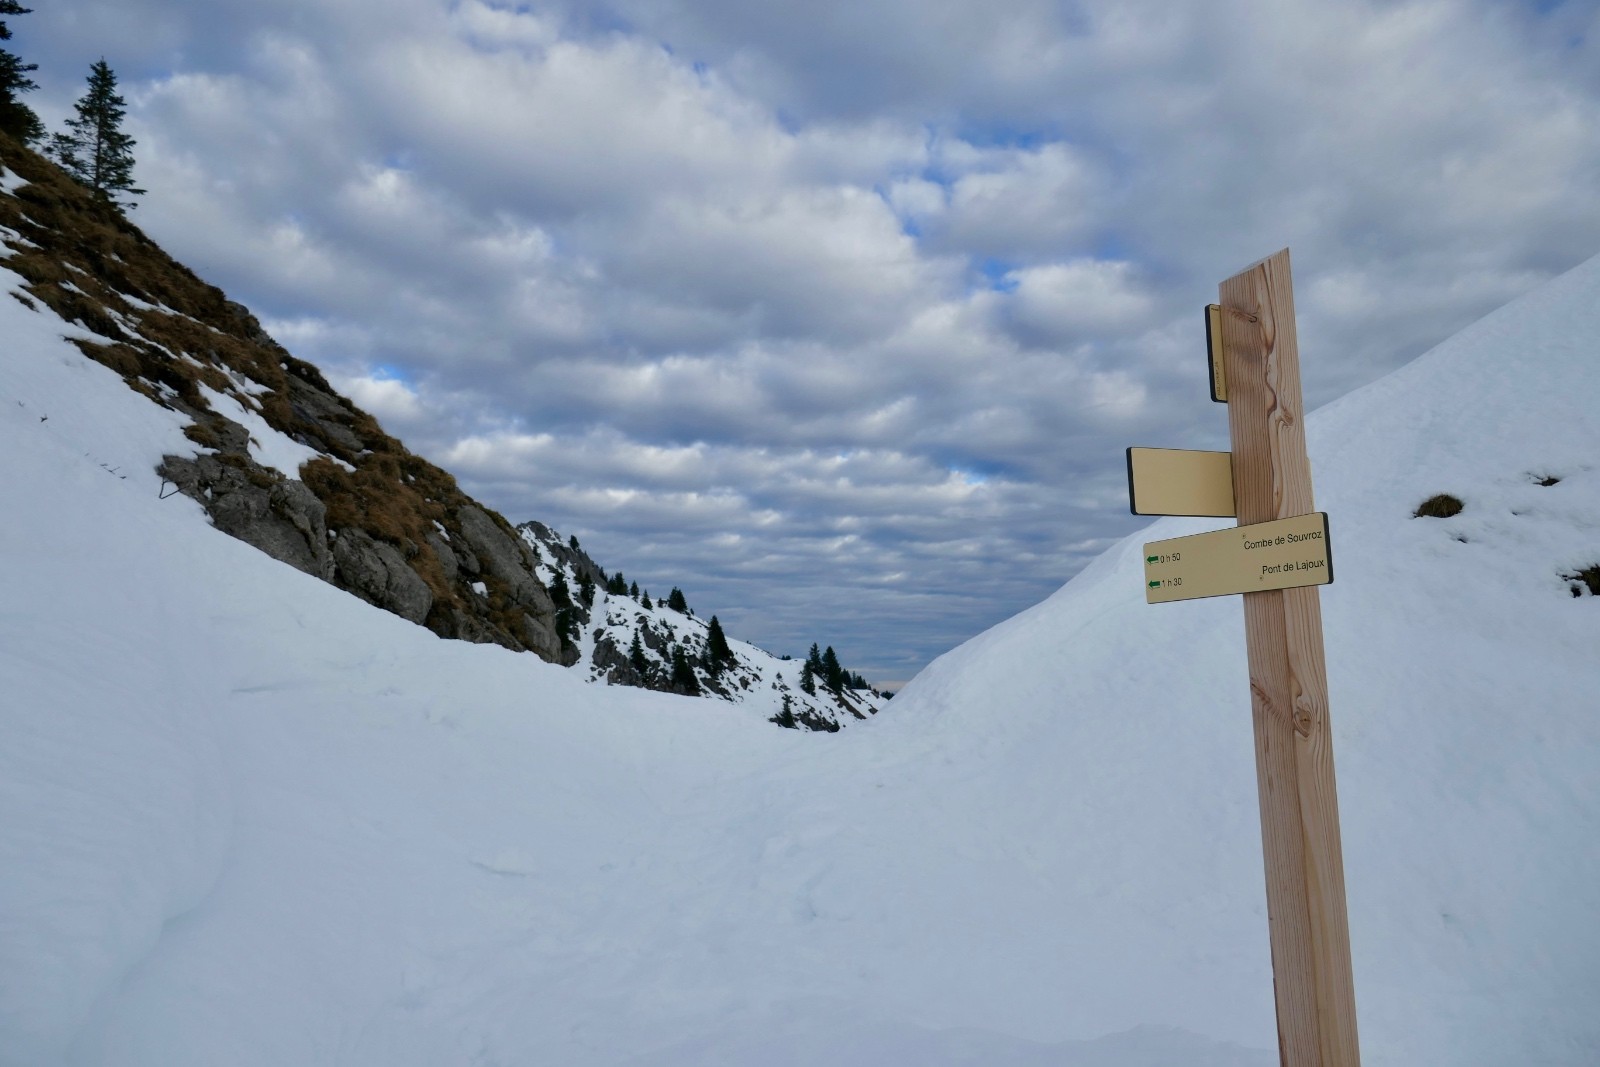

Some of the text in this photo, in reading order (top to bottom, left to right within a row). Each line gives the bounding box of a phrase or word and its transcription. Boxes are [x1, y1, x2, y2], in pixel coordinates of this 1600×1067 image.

[1244, 530, 1322, 550] Combe de Souvroz
[1160, 552, 1181, 563] 0 h 50
[1262, 559, 1325, 575] Pont de Lajoux
[1167, 578, 1172, 587] h
[1173, 577, 1182, 586] 30
